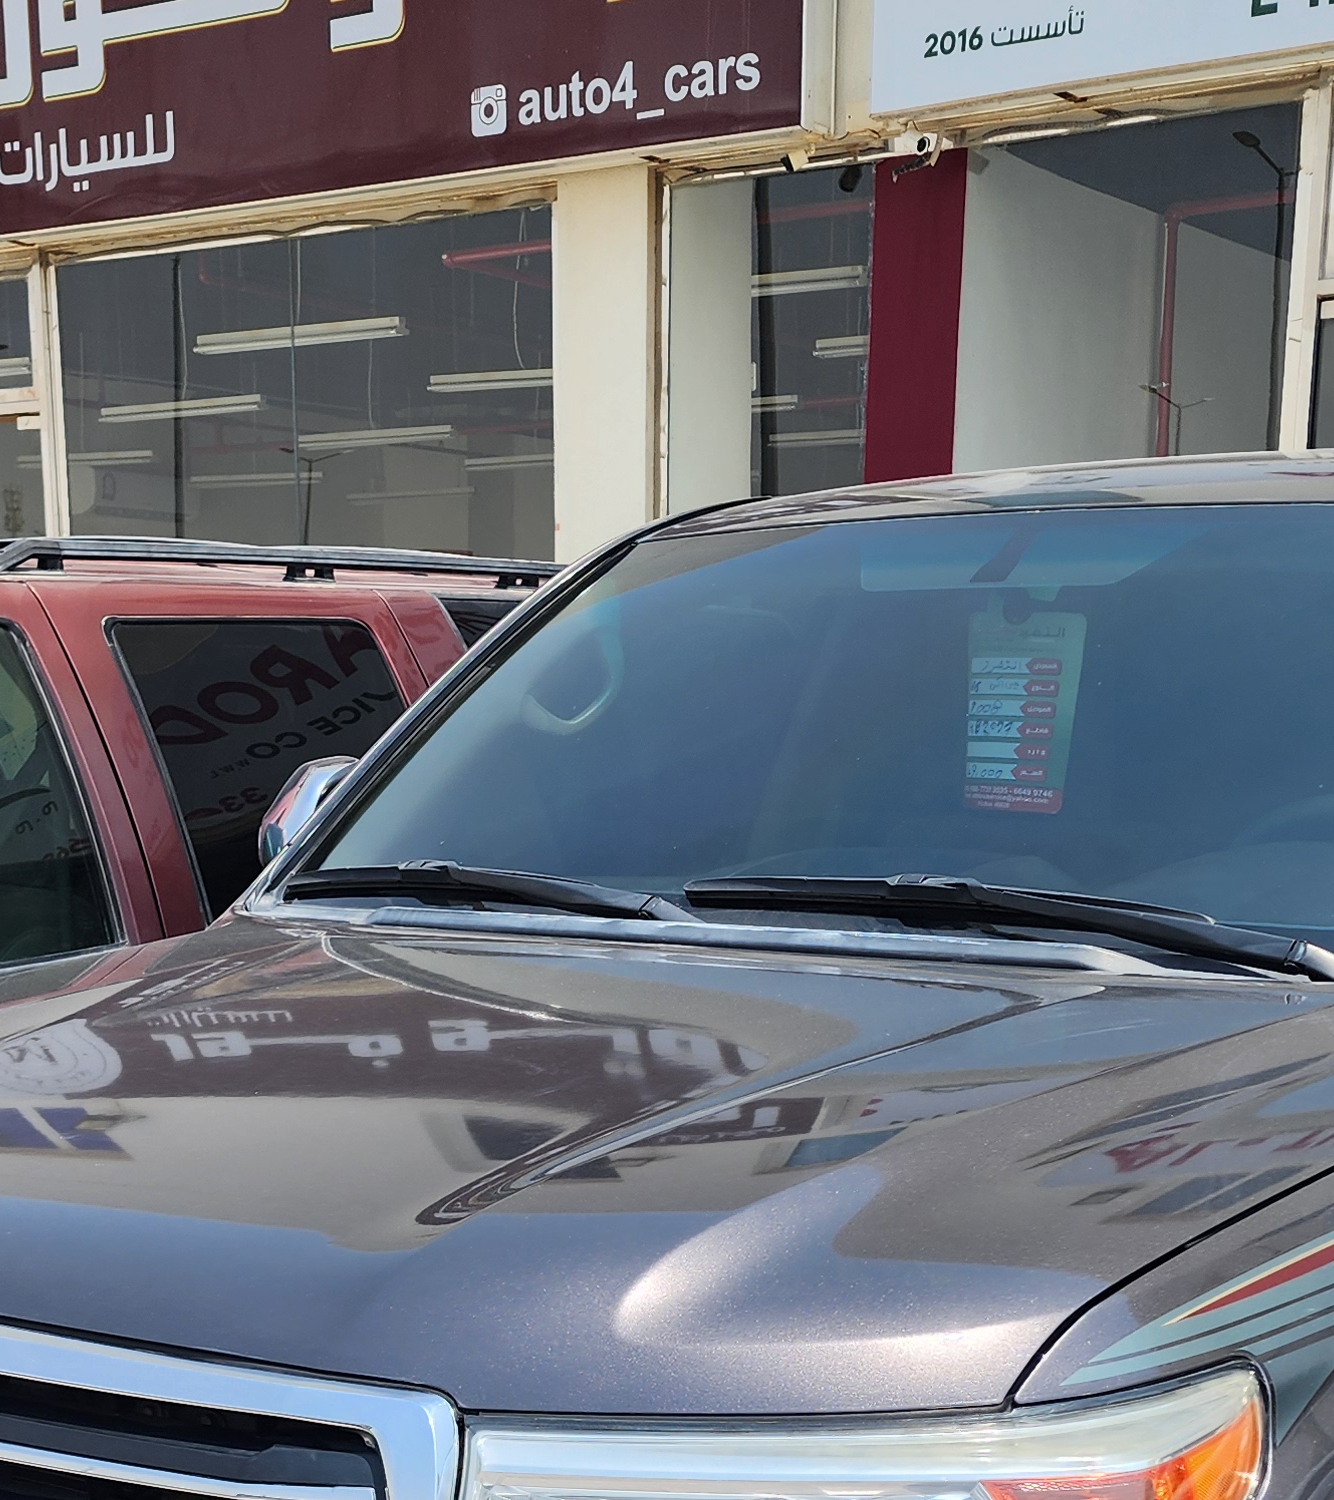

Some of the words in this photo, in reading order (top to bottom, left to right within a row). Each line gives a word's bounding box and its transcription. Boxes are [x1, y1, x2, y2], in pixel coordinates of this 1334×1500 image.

[923, 25, 984, 59] 2016
[990, 5, 1085, 47] تأسست
[517, 52, 761, 126] auto4_cars
